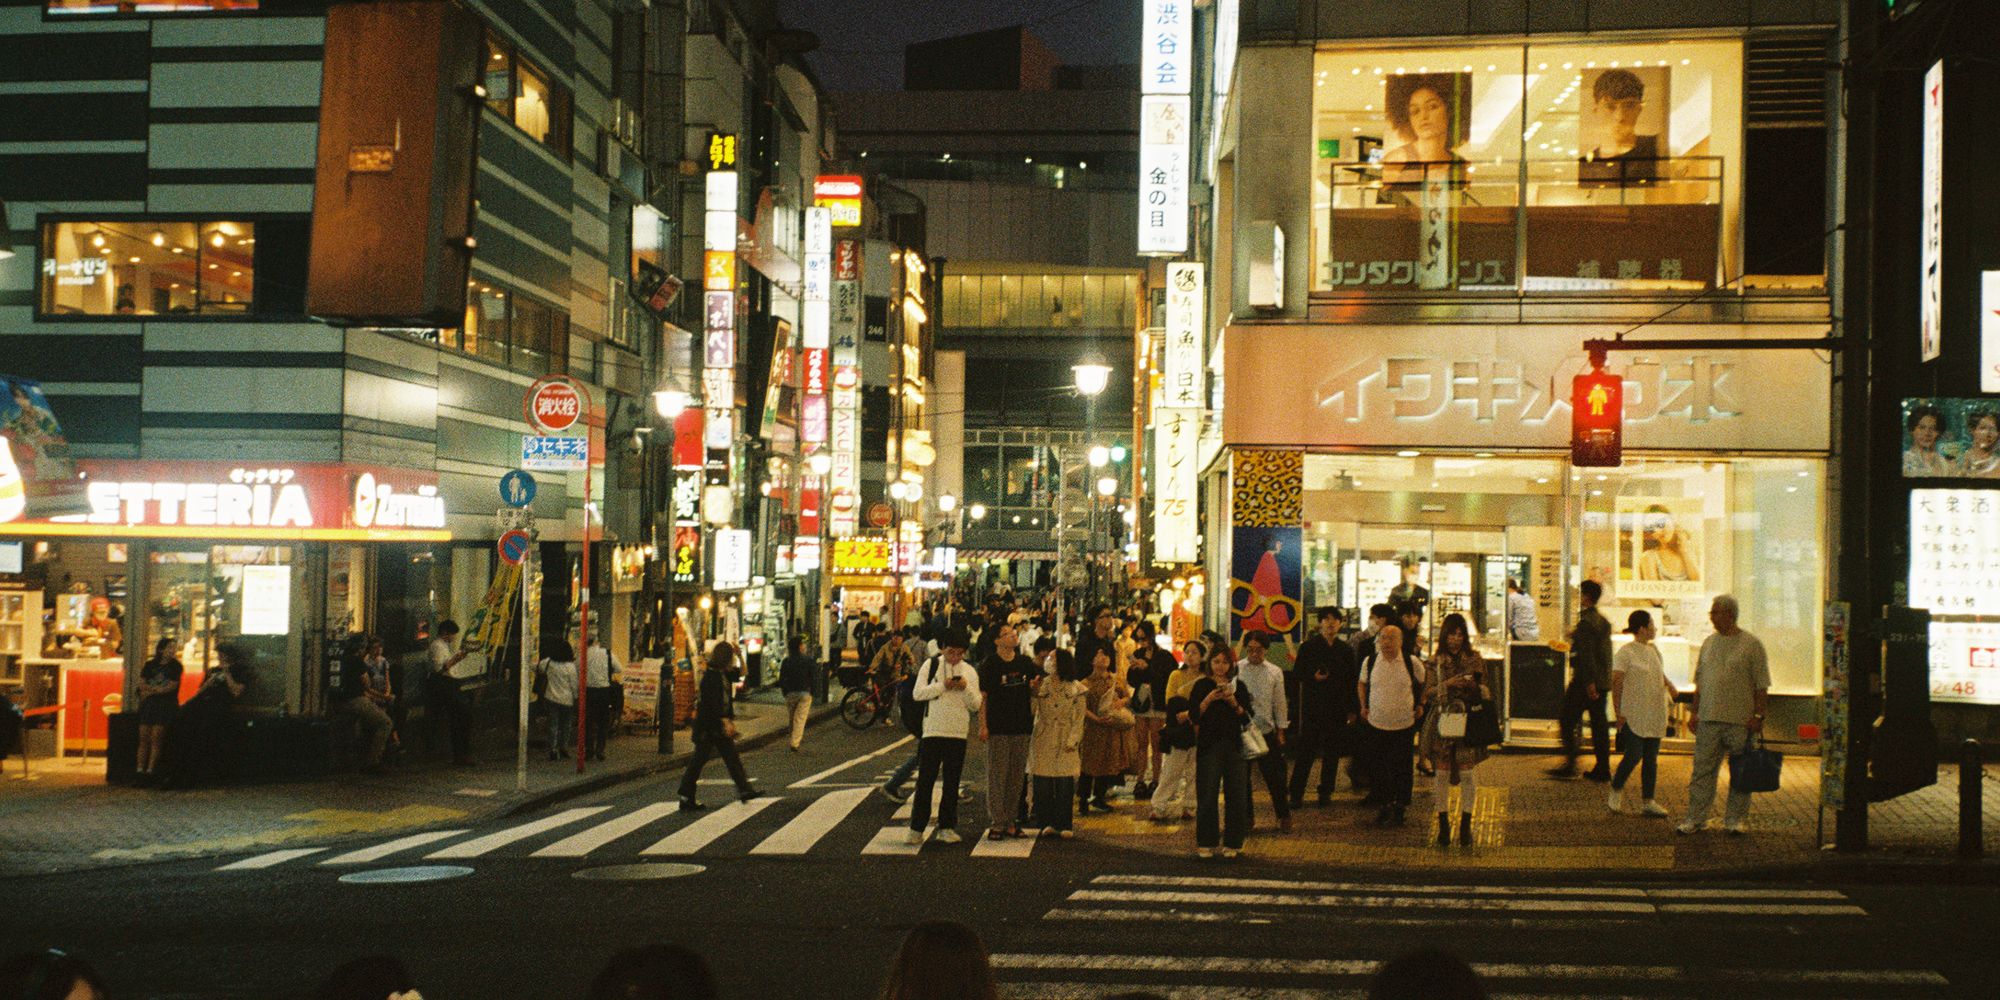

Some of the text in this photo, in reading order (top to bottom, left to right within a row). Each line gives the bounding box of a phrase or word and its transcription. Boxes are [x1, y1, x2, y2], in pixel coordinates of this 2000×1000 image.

[1149, 167, 1167, 228] 金の目
[1321, 260, 1508, 285] コンタクンズ
[537, 397, 577, 416] 消火栓
[50, 482, 313, 527] ETTERIA
[1162, 499, 1187, 516] 75
